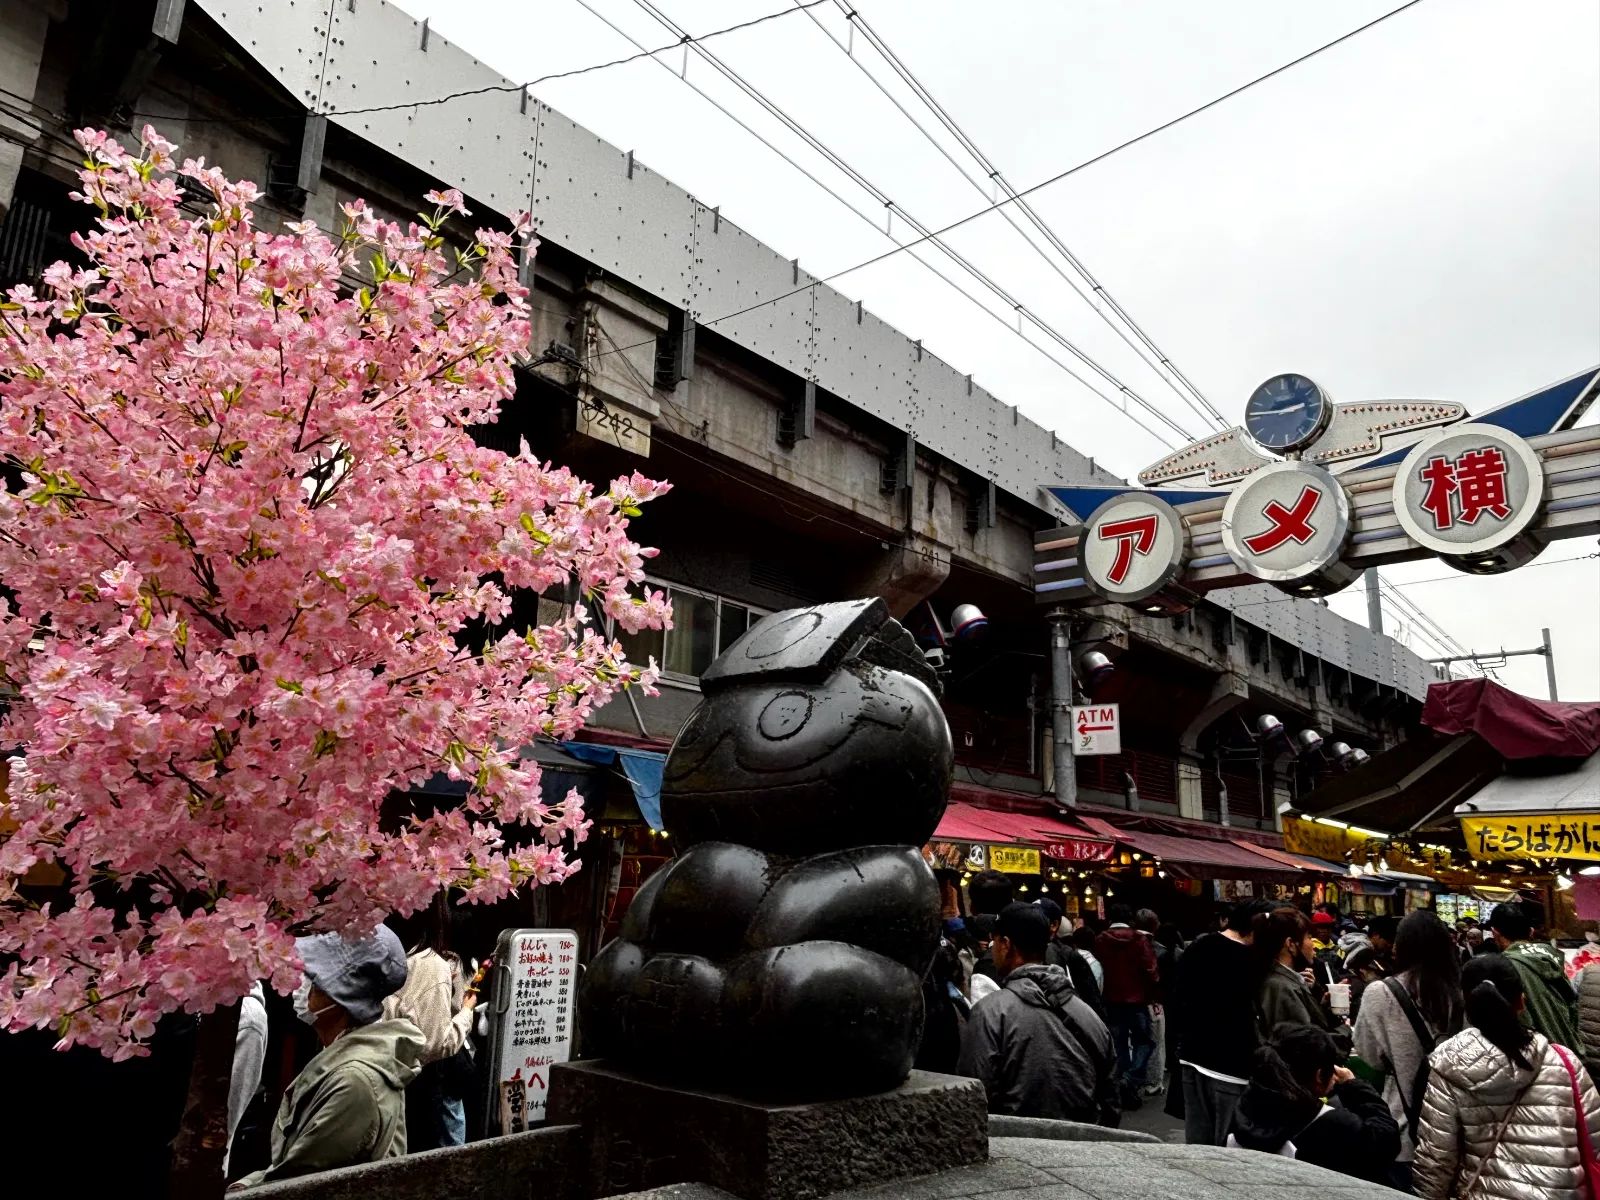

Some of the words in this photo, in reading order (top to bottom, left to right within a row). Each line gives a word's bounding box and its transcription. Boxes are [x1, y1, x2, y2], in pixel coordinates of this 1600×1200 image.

[1099, 446, 1513, 585] アメ横
[1077, 708, 1114, 723] ATM
[1476, 821, 1600, 853] たらばがに
[520, 938, 548, 951] もんじゃ
[518, 952, 553, 964] お好み焼き
